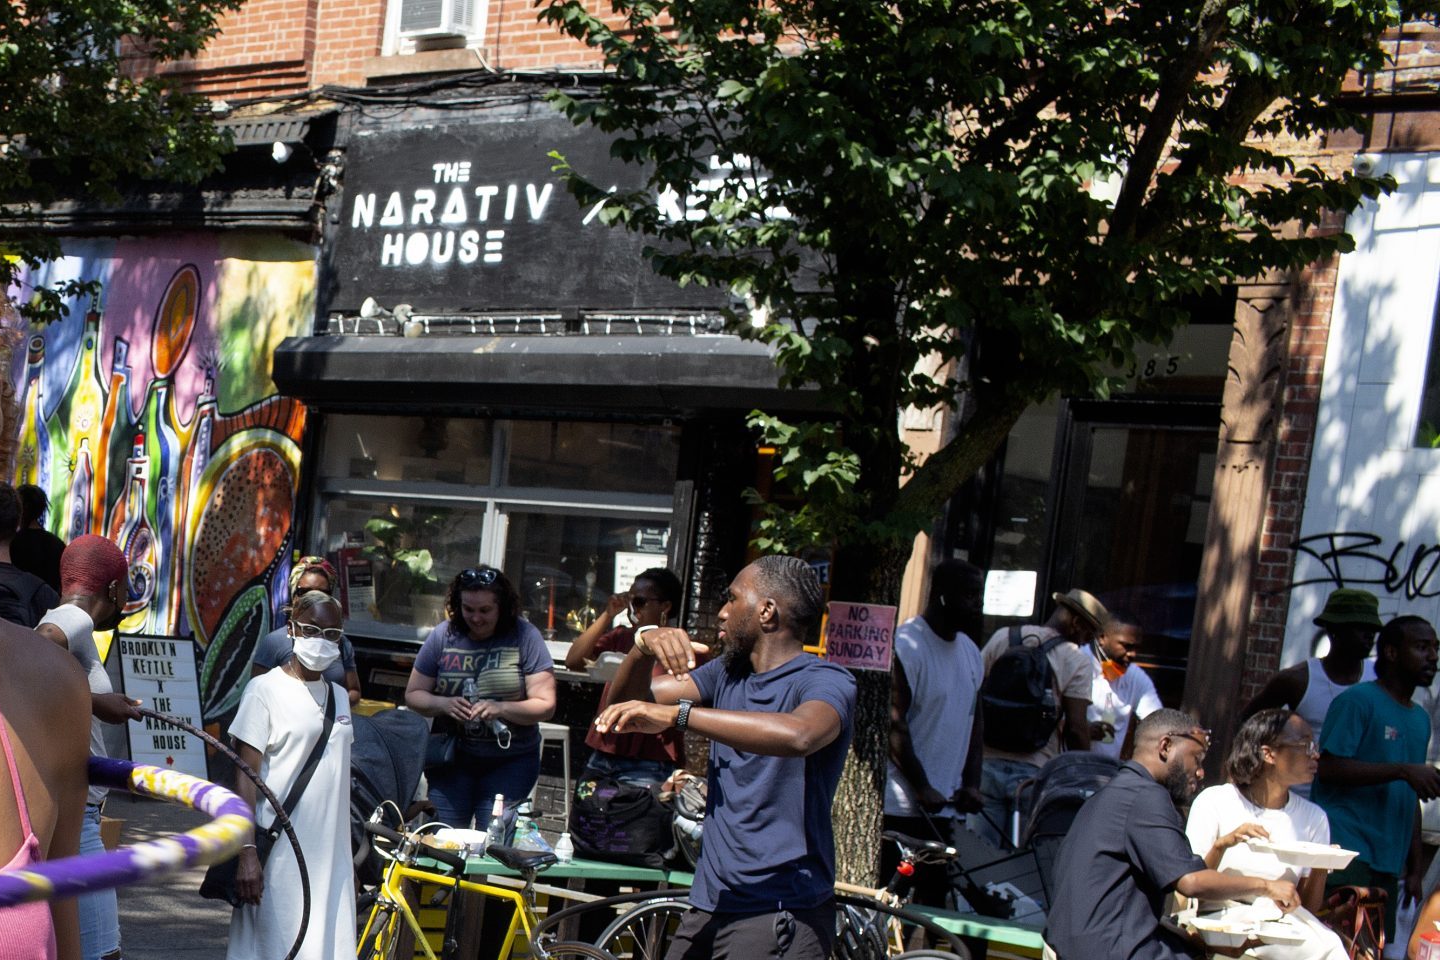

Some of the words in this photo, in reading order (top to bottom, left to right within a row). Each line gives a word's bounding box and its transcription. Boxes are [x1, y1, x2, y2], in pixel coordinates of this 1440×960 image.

[432, 162, 471, 183] THE
[352, 184, 553, 228] NARATIV
[381, 230, 505, 266] HOUSE
[848, 606, 869, 622] NO
[829, 623, 889, 644] PARKING
[121, 640, 177, 657] BROOKLYN
[828, 641, 886, 661] SUNDAY
[132, 658, 174, 676] KETTLE
[152, 697, 171, 712] THE
[153, 735, 186, 750] HOUSE
